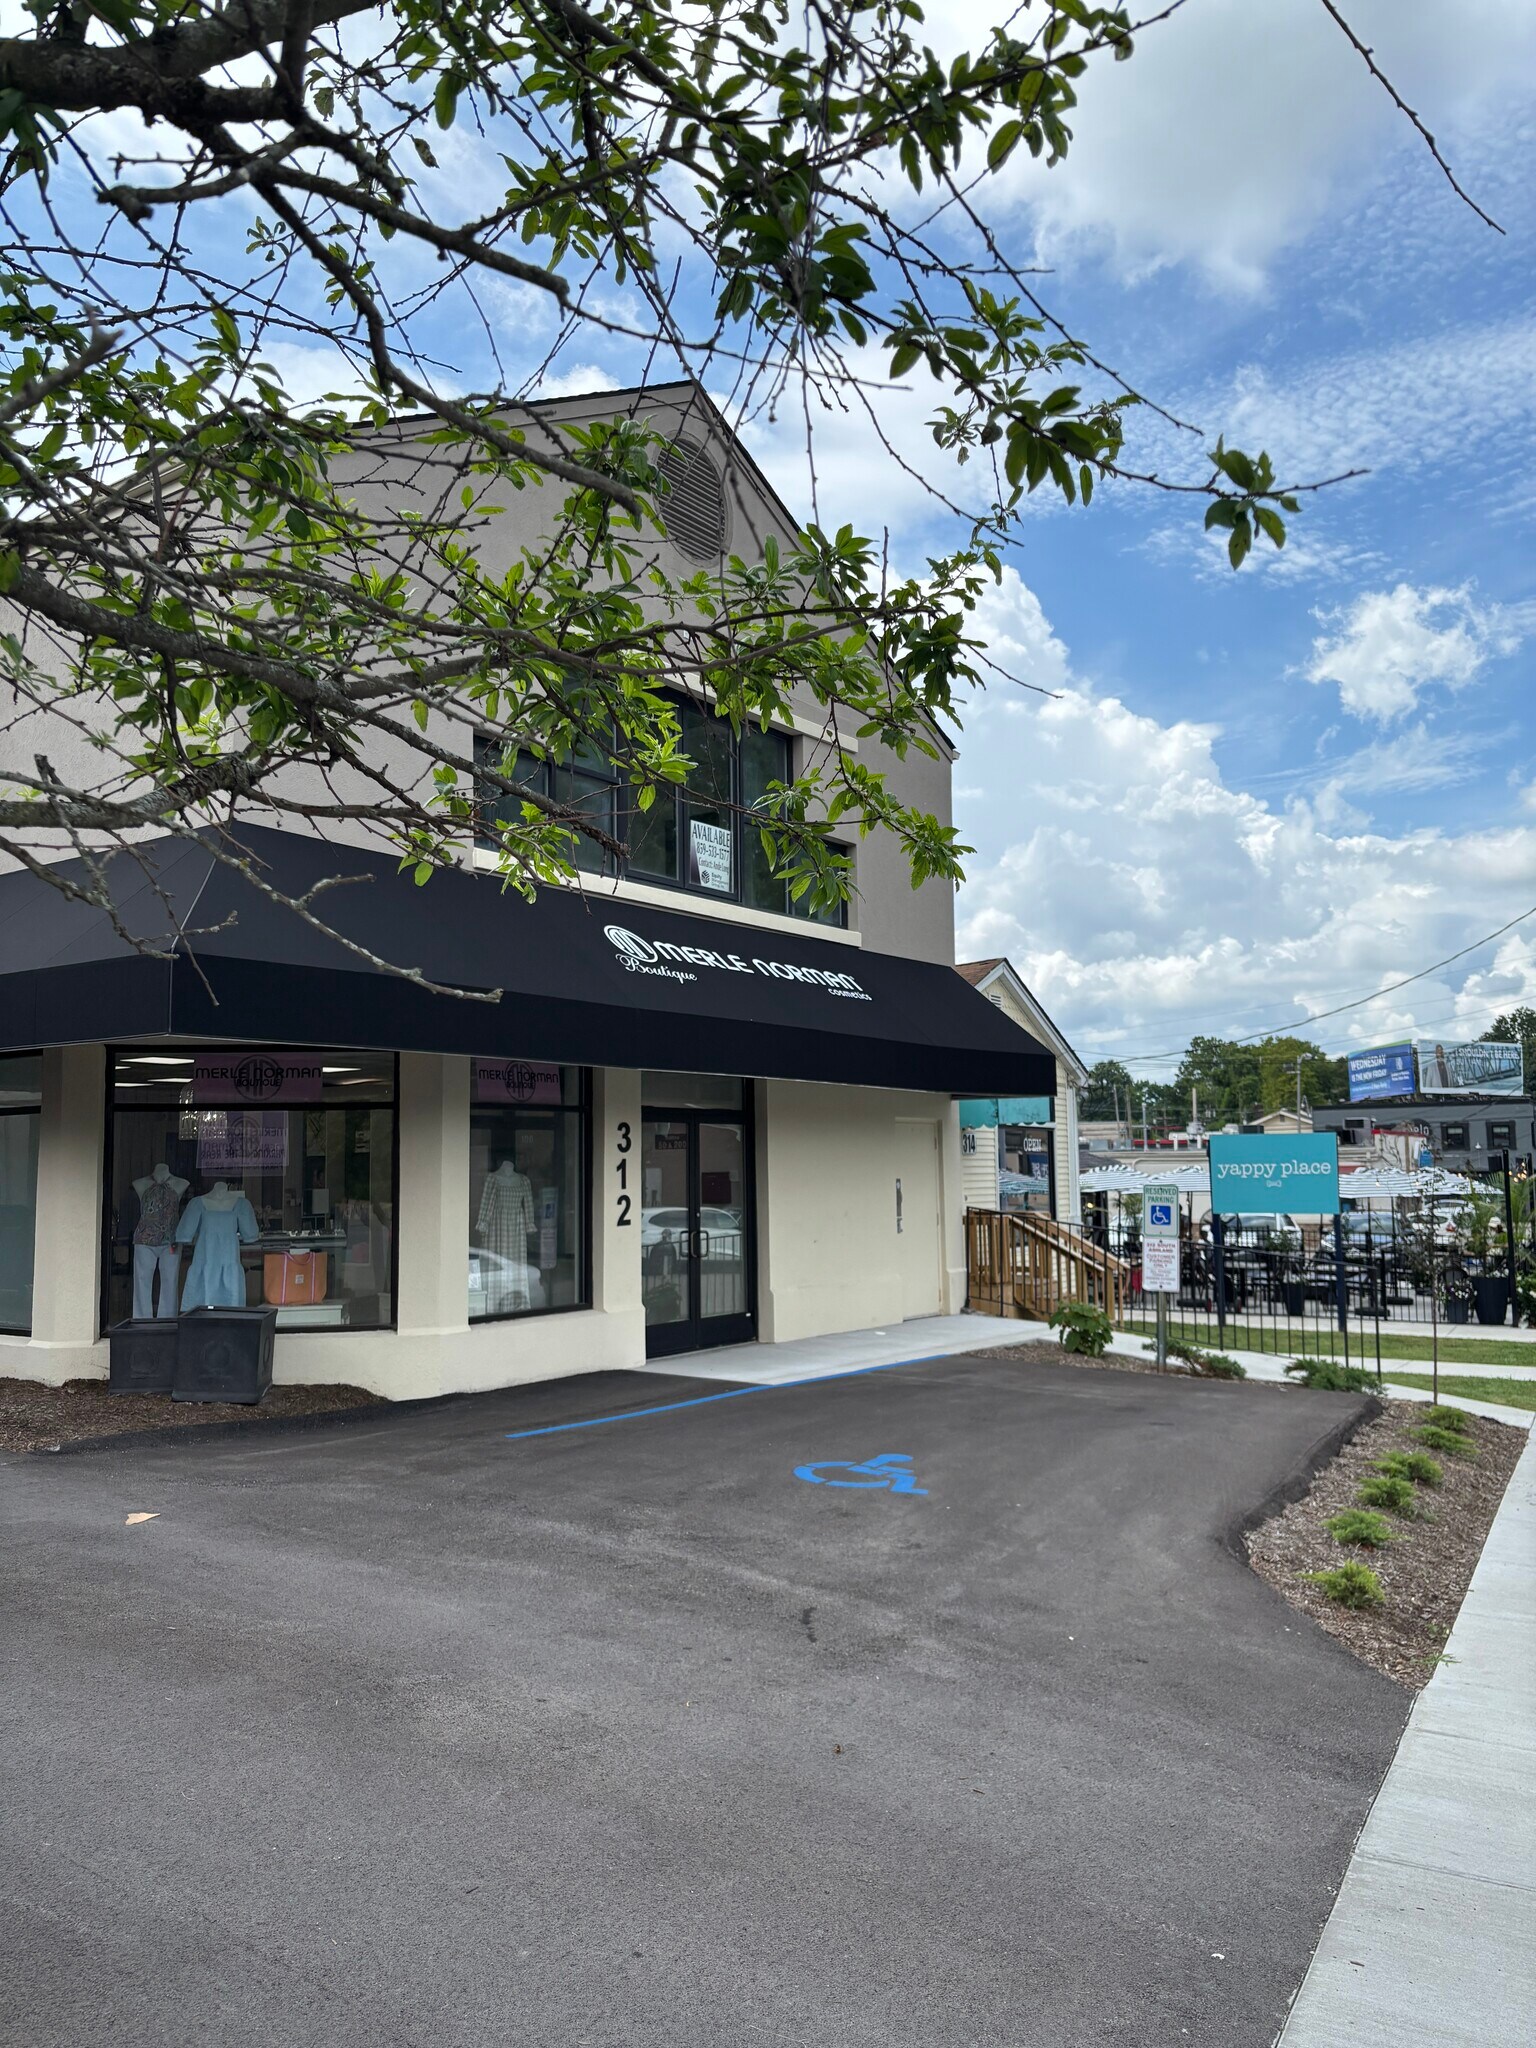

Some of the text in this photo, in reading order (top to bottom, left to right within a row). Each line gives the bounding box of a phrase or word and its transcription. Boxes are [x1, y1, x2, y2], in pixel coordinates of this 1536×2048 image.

[692, 823, 730, 848] AVAILABLE
[696, 841, 730, 861] 859-533-1577
[616, 954, 697, 984] Boutique
[653, 941, 863, 991] MERLE NORMAN
[828, 988, 873, 1001] cosmetics
[1351, 1053, 1386, 1071] WEDNESDAY
[1495, 1049, 1503, 1058] BE
[195, 1067, 321, 1079] MERLE NORMAN
[479, 1069, 559, 1083] MERLE NORMAN
[237, 1078, 281, 1087] BOUTIQUE
[962, 1134, 976, 1153] 314
[616, 1121, 632, 1227] 312
[1218, 1160, 1331, 1178] yappy place
[1145, 1187, 1177, 1196] RESERVED
[1147, 1195, 1174, 1203] PARKING
